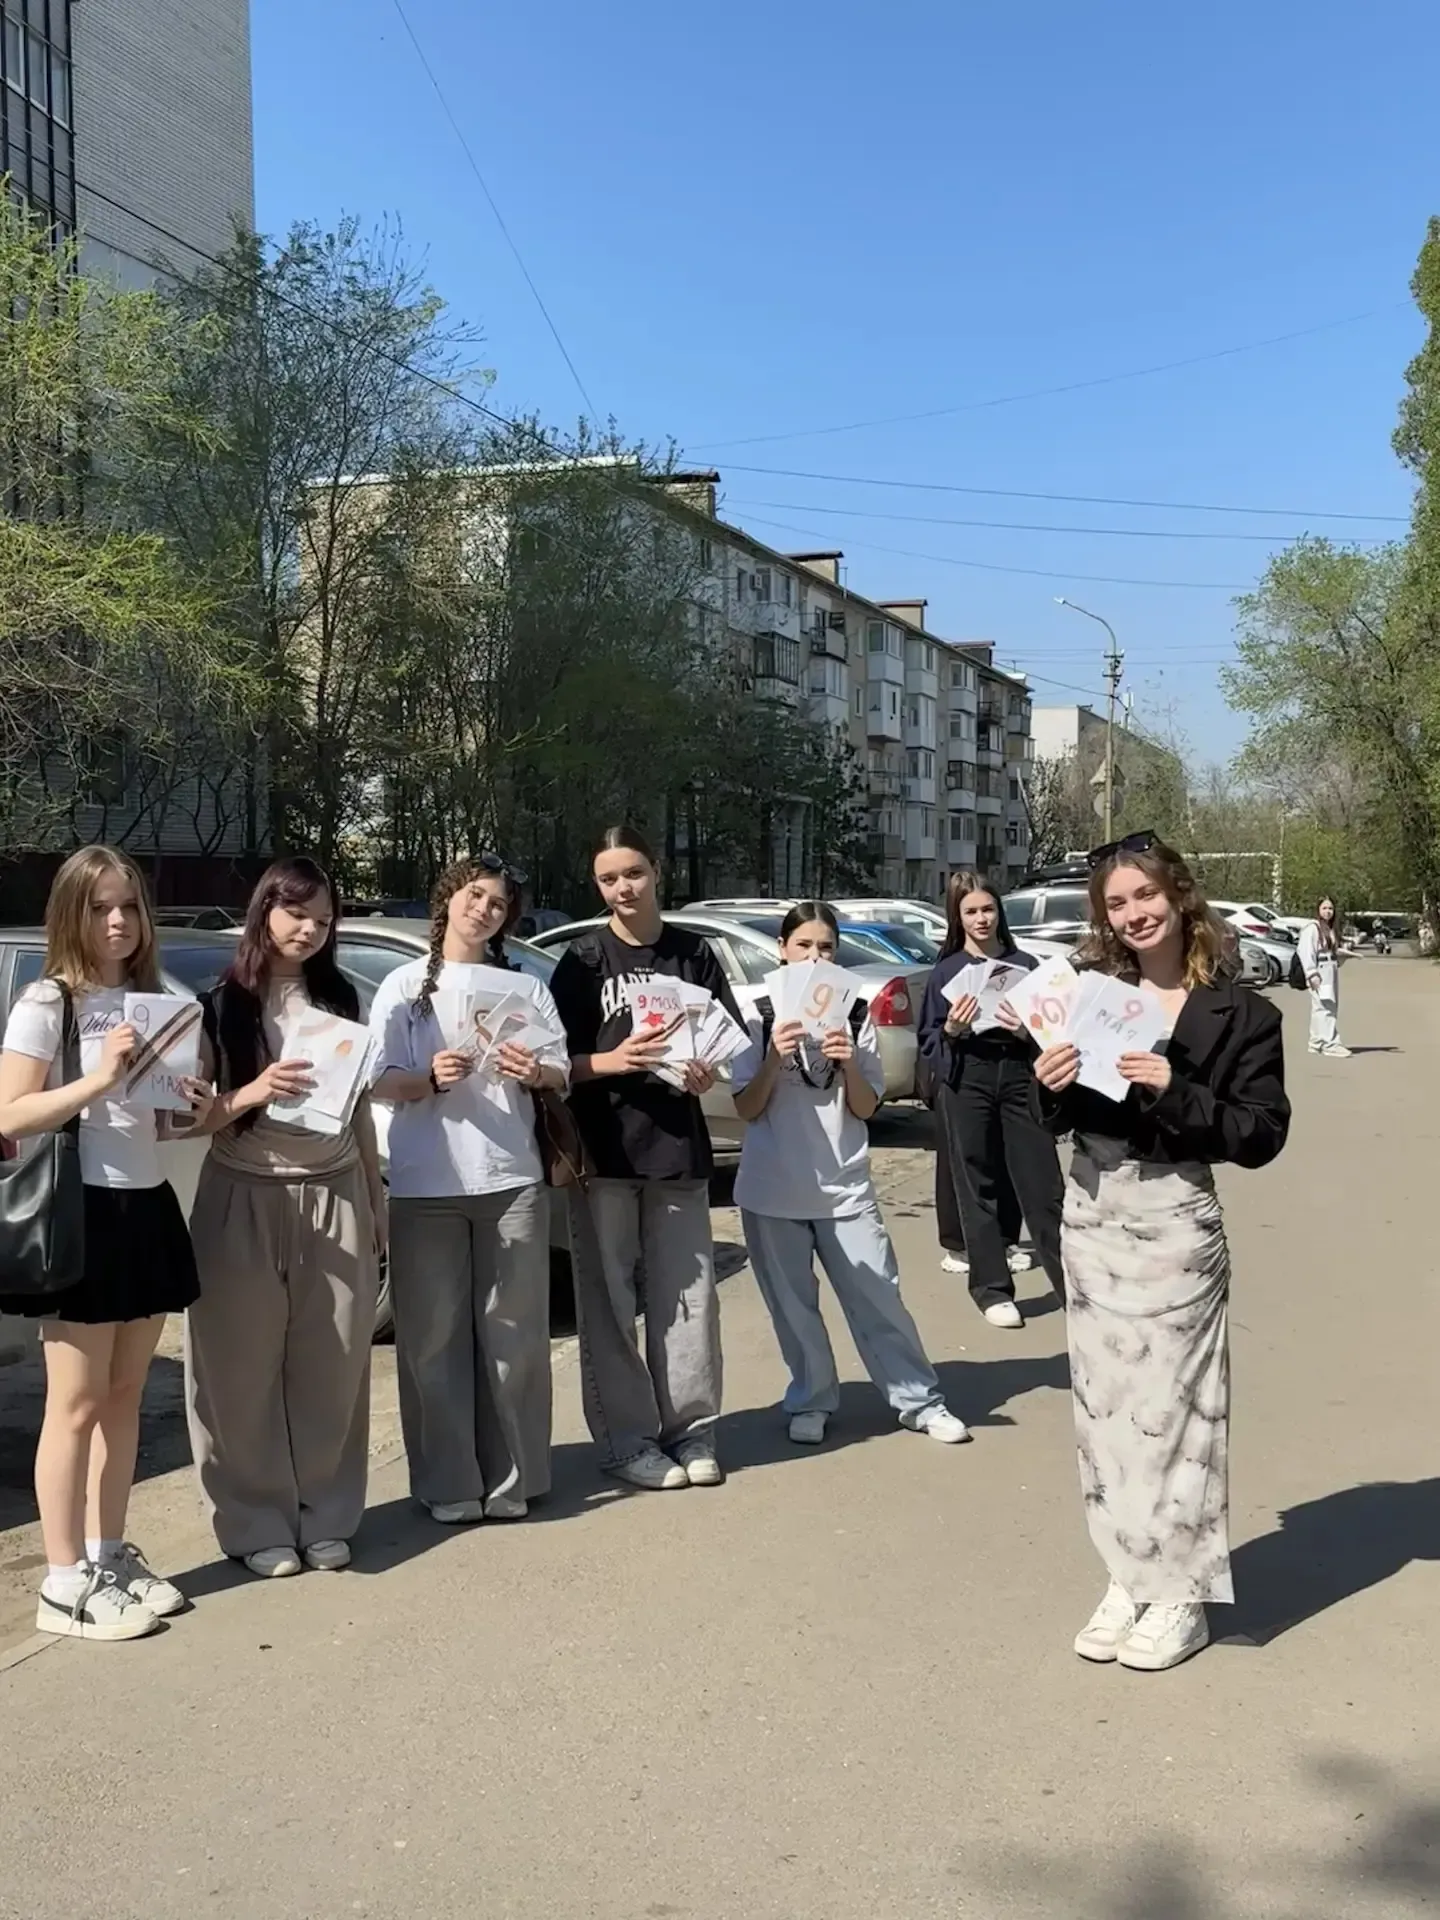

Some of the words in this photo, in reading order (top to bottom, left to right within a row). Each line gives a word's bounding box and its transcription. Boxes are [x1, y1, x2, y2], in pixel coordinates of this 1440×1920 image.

[637, 994, 648, 1010] 9
[805, 983, 834, 1019] 9
[1121, 999, 1145, 1022] 9
[133, 1003, 150, 1036] 9
